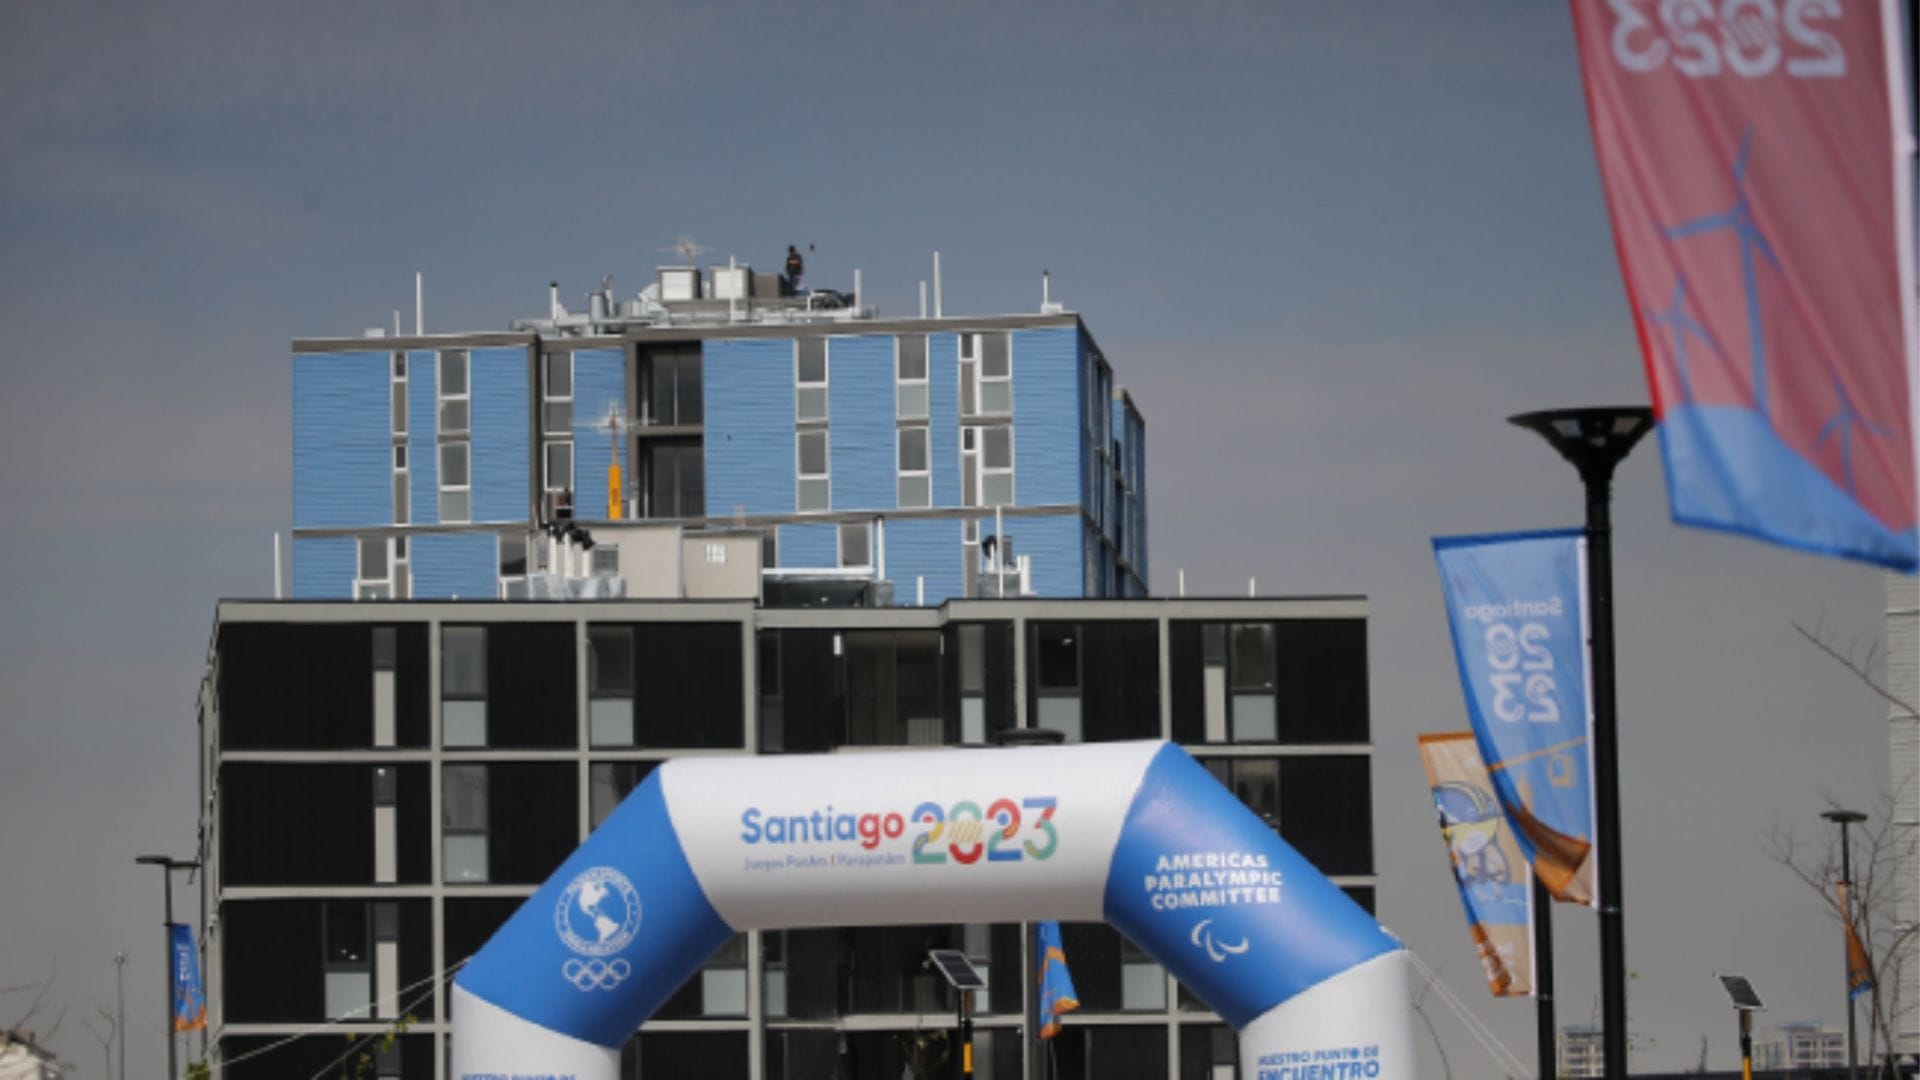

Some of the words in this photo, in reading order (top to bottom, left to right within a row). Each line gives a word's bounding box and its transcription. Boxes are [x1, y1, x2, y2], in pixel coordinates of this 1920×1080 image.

[740, 804, 905, 850] Santiago
[910, 796, 1059, 865] 2023
[1155, 851, 1269, 872] AMERICAS
[1143, 869, 1284, 891] PARALYMPIC
[1151, 886, 1281, 910] COMMITTEE
